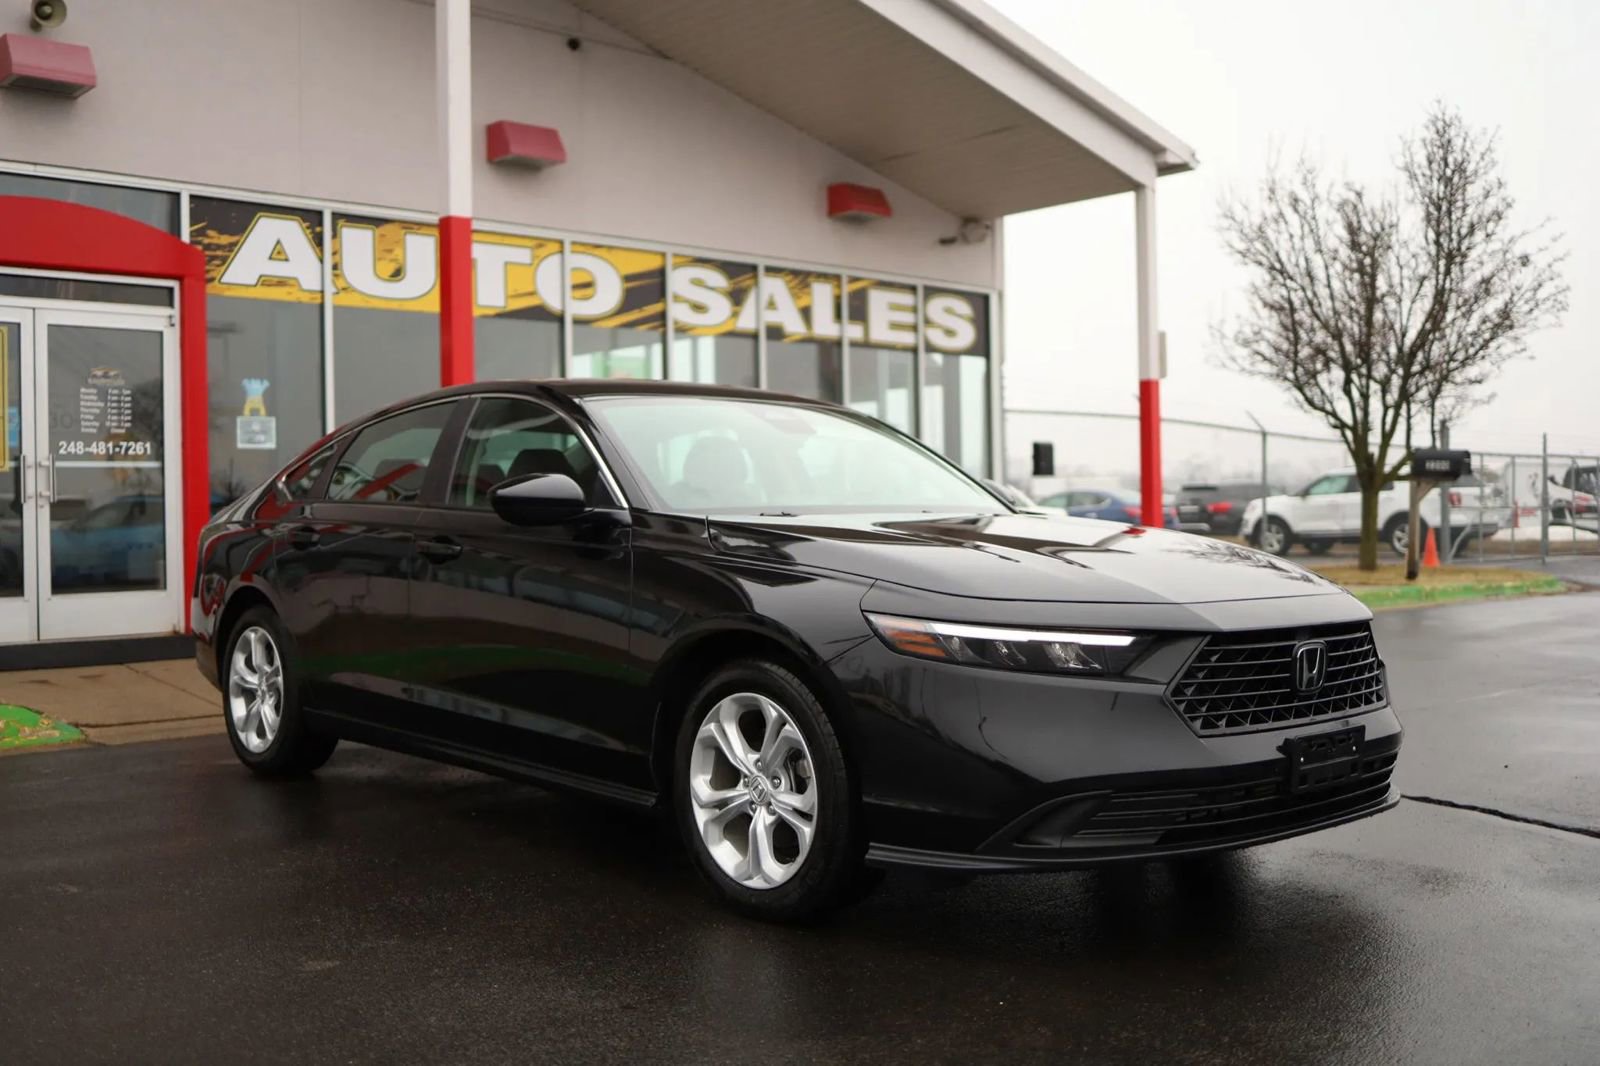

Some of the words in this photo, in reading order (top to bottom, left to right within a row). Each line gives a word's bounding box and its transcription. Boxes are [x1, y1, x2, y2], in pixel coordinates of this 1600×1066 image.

[218, 212, 625, 320] AUTO
[668, 263, 977, 352] SALES
[58, 440, 151, 456] 248-481-7261
